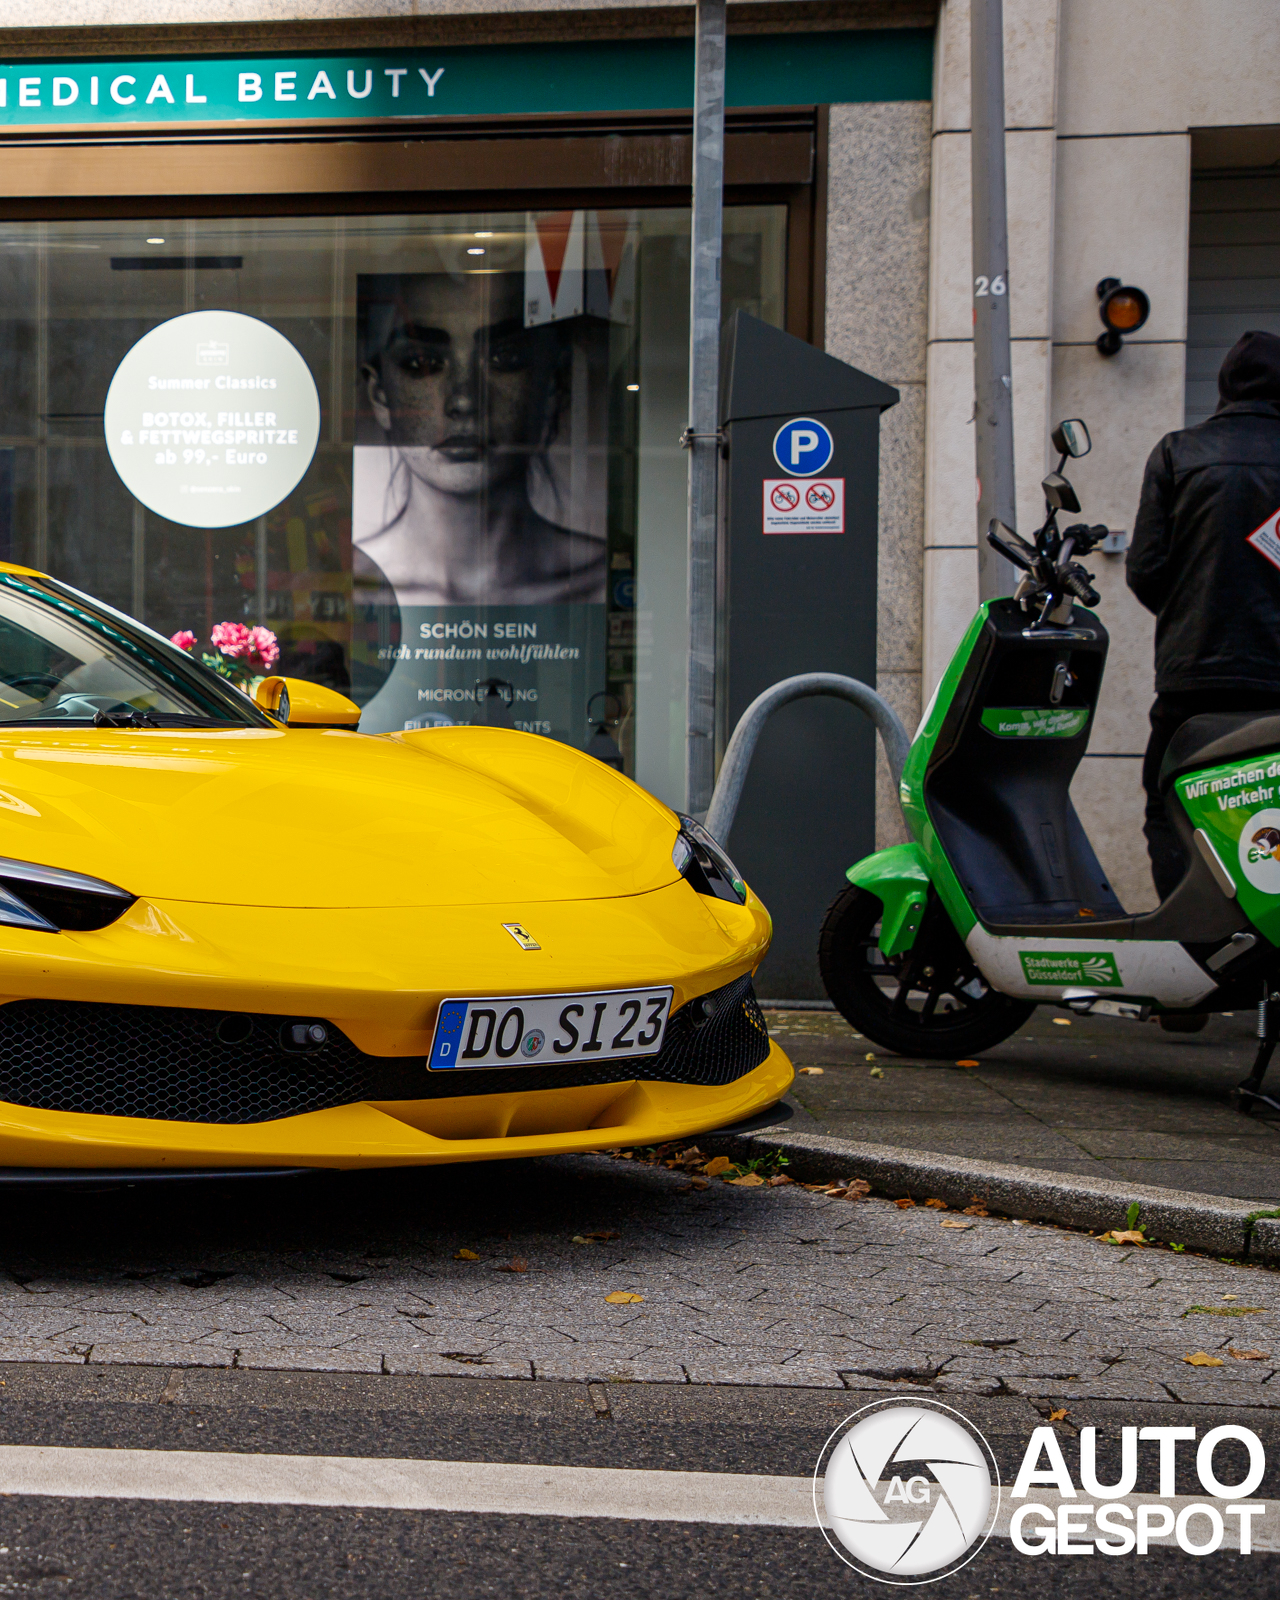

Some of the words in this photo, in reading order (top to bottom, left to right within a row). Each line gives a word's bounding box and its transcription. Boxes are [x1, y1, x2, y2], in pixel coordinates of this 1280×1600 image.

[237, 67, 445, 102] BEAUTY
[974, 274, 1007, 298] 26
[148, 375, 211, 391] Summer
[214, 375, 277, 390] Classics
[142, 412, 213, 429] BOTOX,
[217, 412, 277, 427] FILLER
[120, 430, 135, 446] &
[138, 430, 298, 445] FETTWEGSPRITZE
[790, 429, 820, 466] P
[154, 448, 178, 465] ab
[225, 448, 268, 465] Euro
[419, 619, 488, 639] SCHÖN
[493, 623, 538, 639] SEIN
[377, 644, 411, 660] sich
[414, 645, 483, 660] rundum
[486, 644, 580, 664] wohlfühlen
[1185, 782, 1210, 800] Wir
[1211, 768, 1265, 793] machen
[1217, 785, 1275, 812] Verkehr
[1024, 956, 1080, 970] Stadtwerke
[1028, 969, 1084, 982] Düsseldorf
[439, 1042, 451, 1057] D
[461, 1006, 525, 1059] DO
